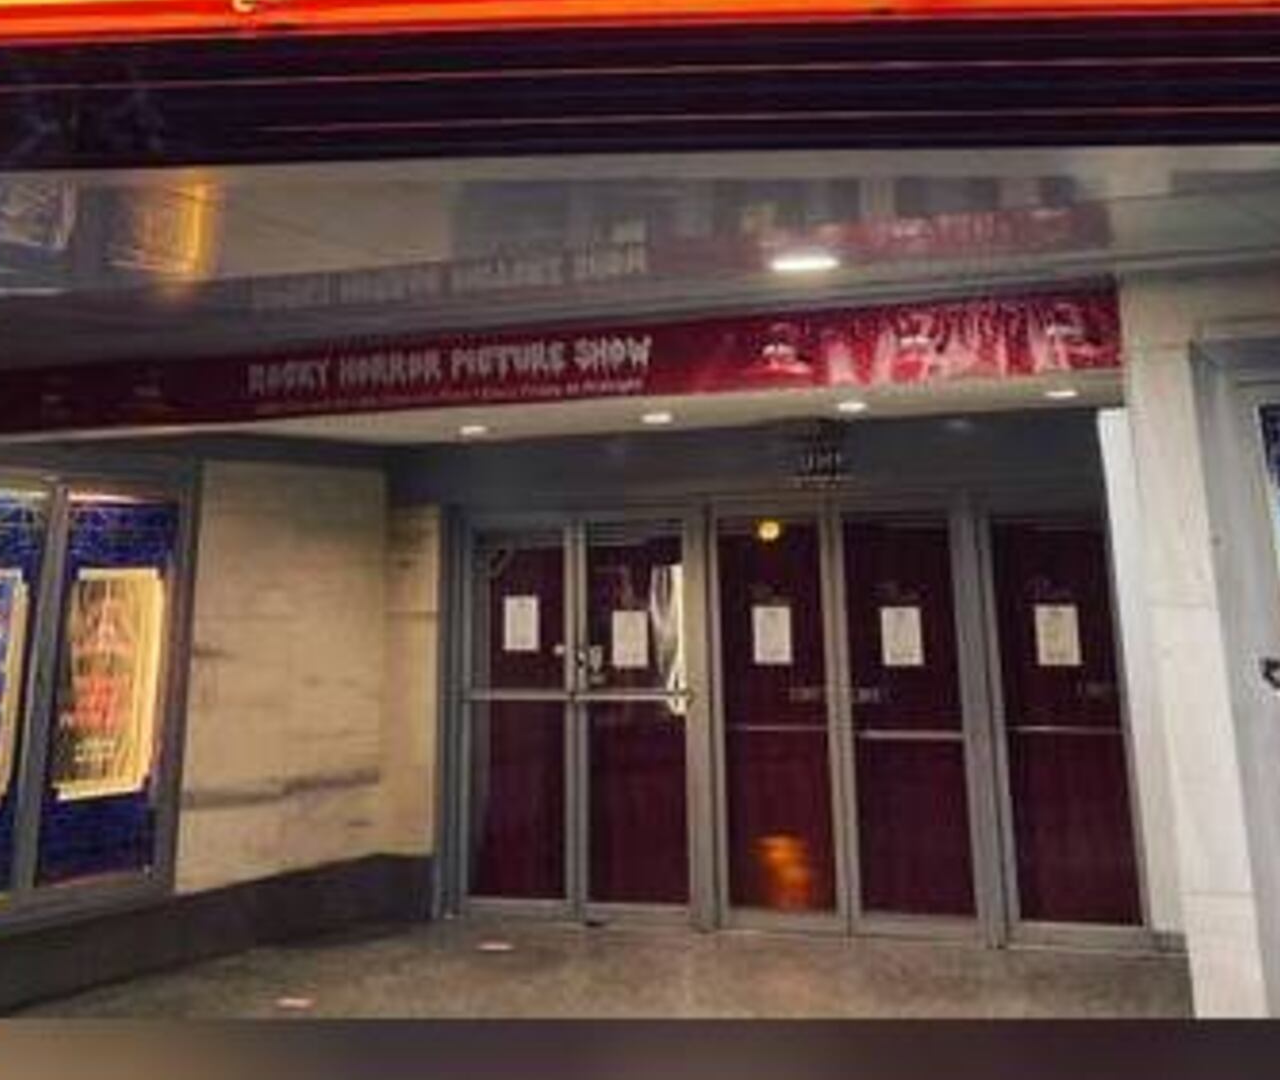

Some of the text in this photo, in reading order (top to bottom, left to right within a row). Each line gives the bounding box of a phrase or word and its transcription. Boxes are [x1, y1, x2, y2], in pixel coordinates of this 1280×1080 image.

[339, 348, 442, 389] HORROR
[451, 341, 566, 381] PICTURE
[573, 334, 653, 374] SHOW
